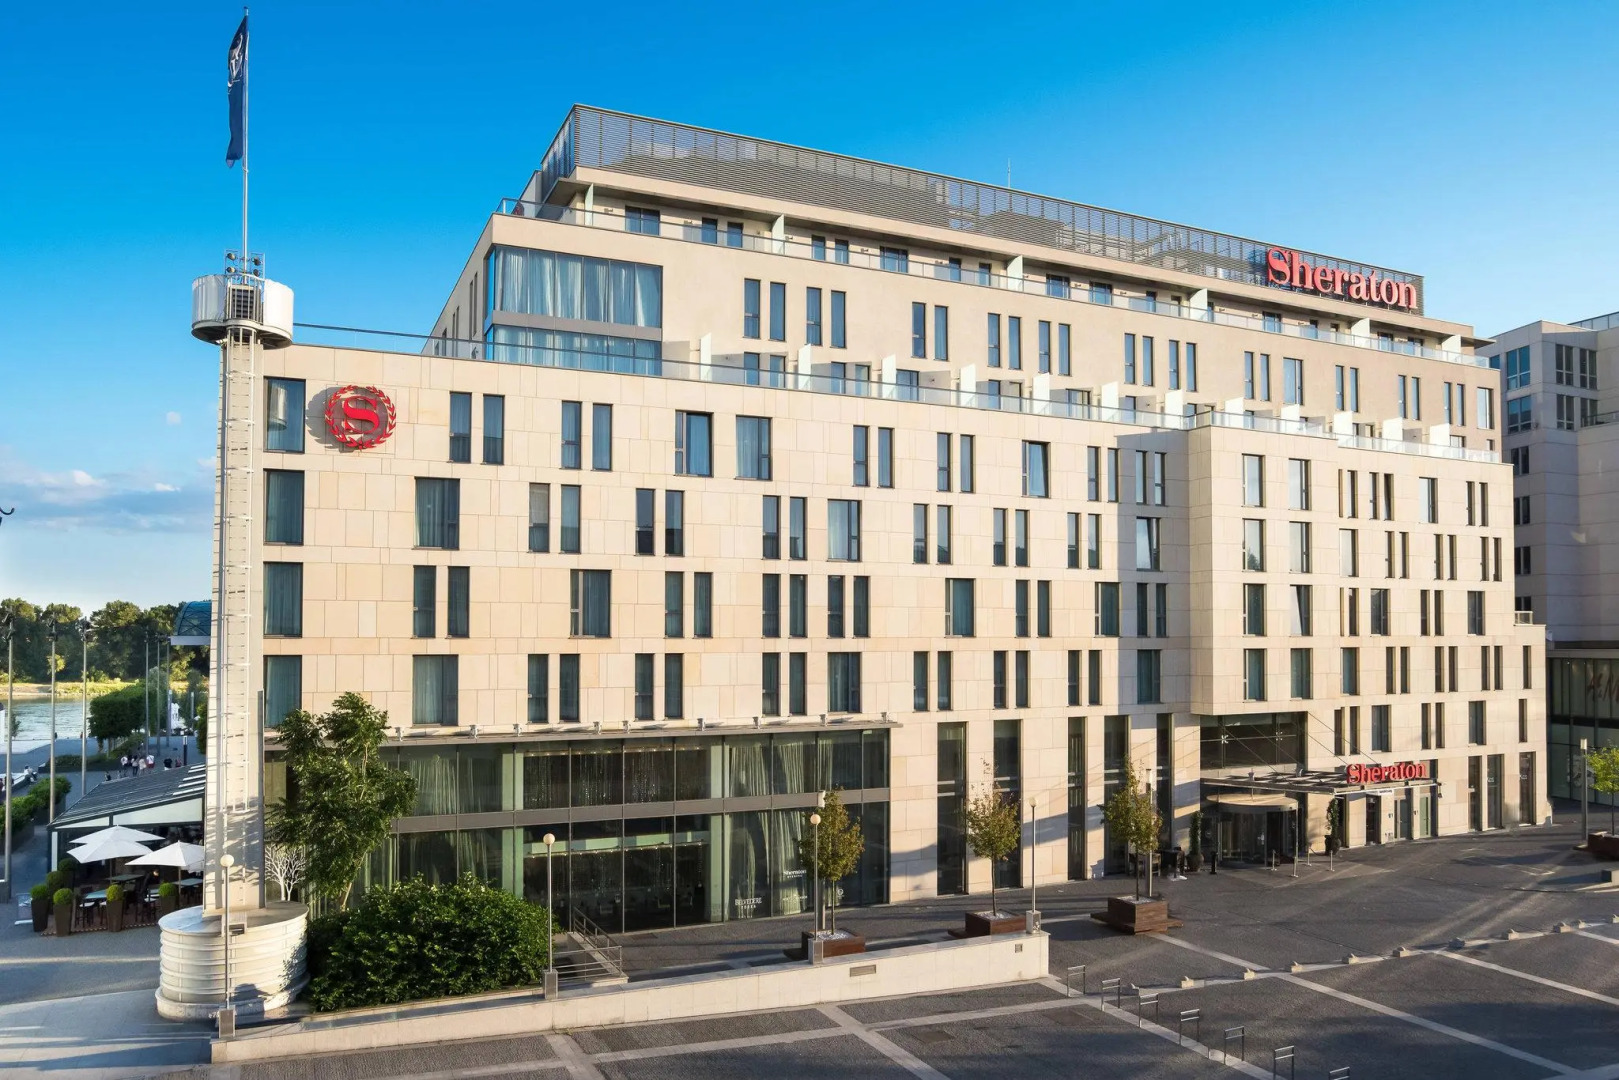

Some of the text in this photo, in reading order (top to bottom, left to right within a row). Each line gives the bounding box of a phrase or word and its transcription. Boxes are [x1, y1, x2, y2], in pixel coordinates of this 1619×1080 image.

[1267, 247, 1418, 309] Sheraton
[343, 395, 380, 434] S
[1346, 761, 1427, 784] Sheraton
